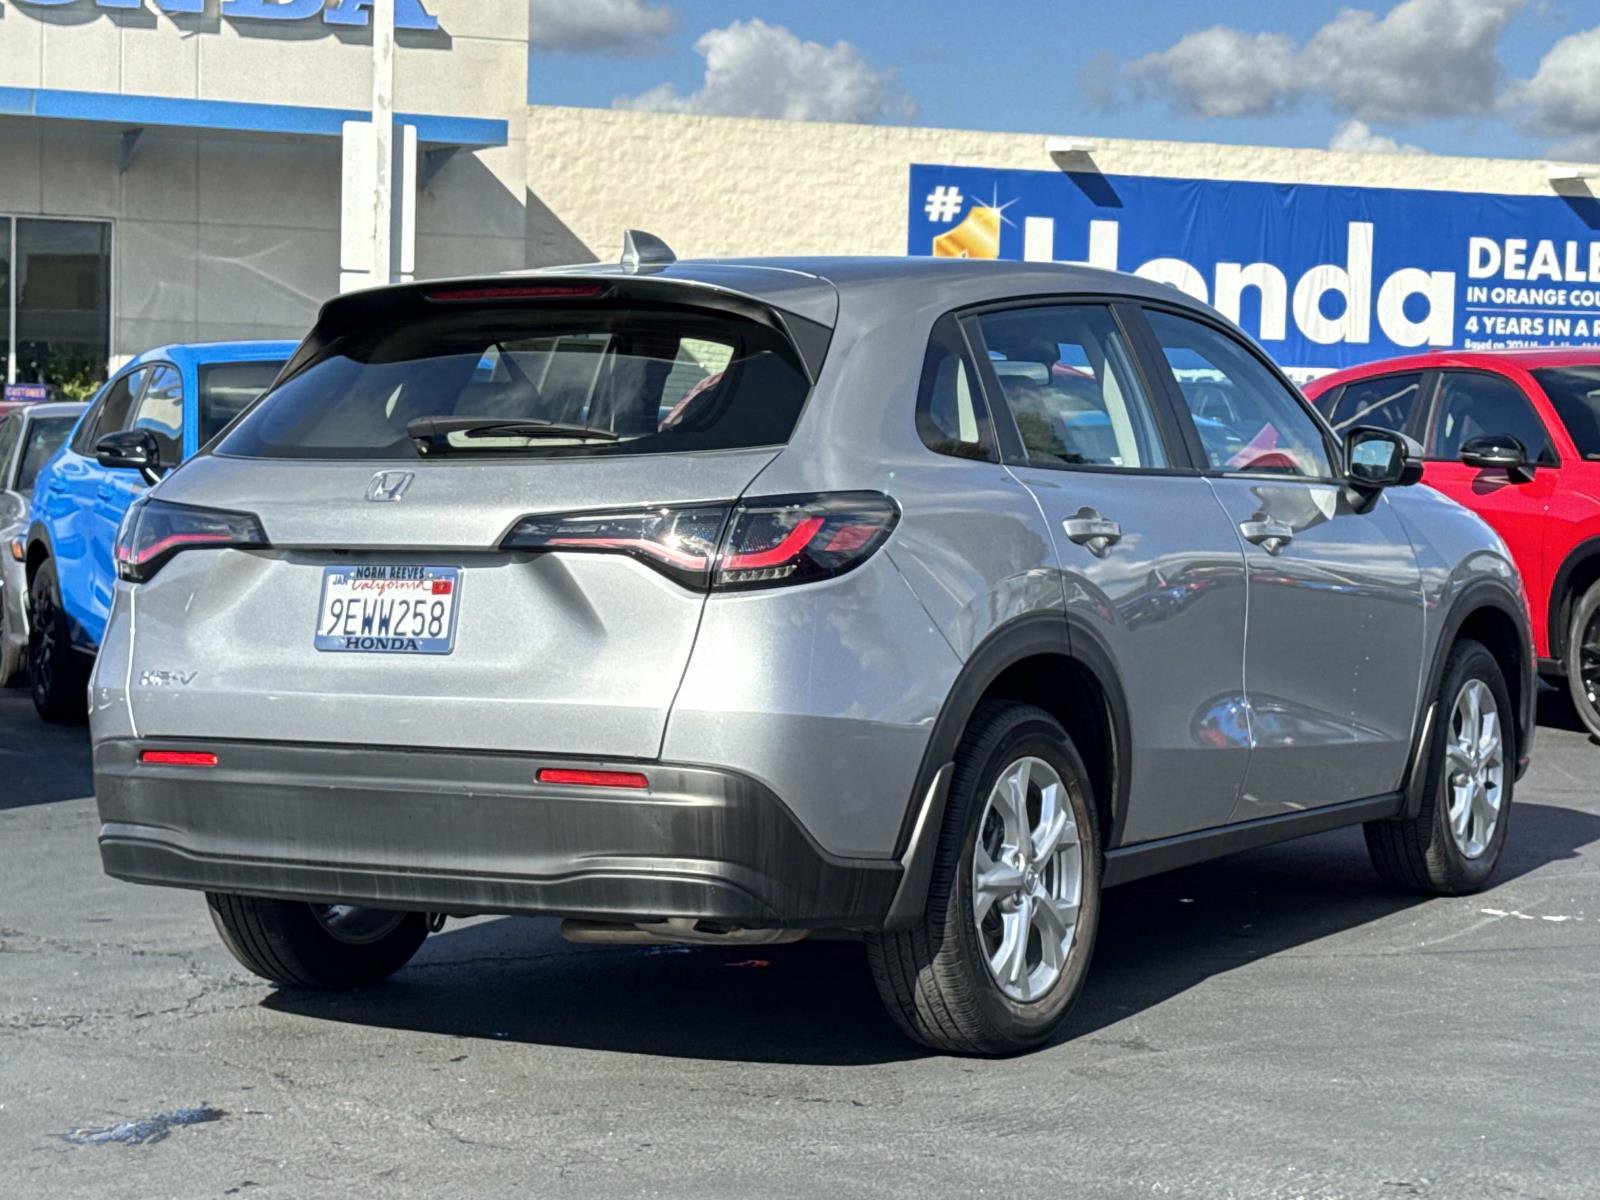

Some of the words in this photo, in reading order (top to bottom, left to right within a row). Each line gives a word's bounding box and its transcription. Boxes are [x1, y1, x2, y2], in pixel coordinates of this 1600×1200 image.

[1467, 286, 1488, 303] IN
[1491, 287, 1567, 305] ORANGE
[1465, 316, 1479, 333] 4
[1483, 316, 1544, 335] YEARS
[1548, 319, 1571, 336] IN
[1574, 319, 1590, 337] A
[356, 567, 386, 579] NORM
[390, 567, 425, 580] REEVES
[327, 598, 445, 637] 9EWW258
[344, 637, 420, 650] HONDA
